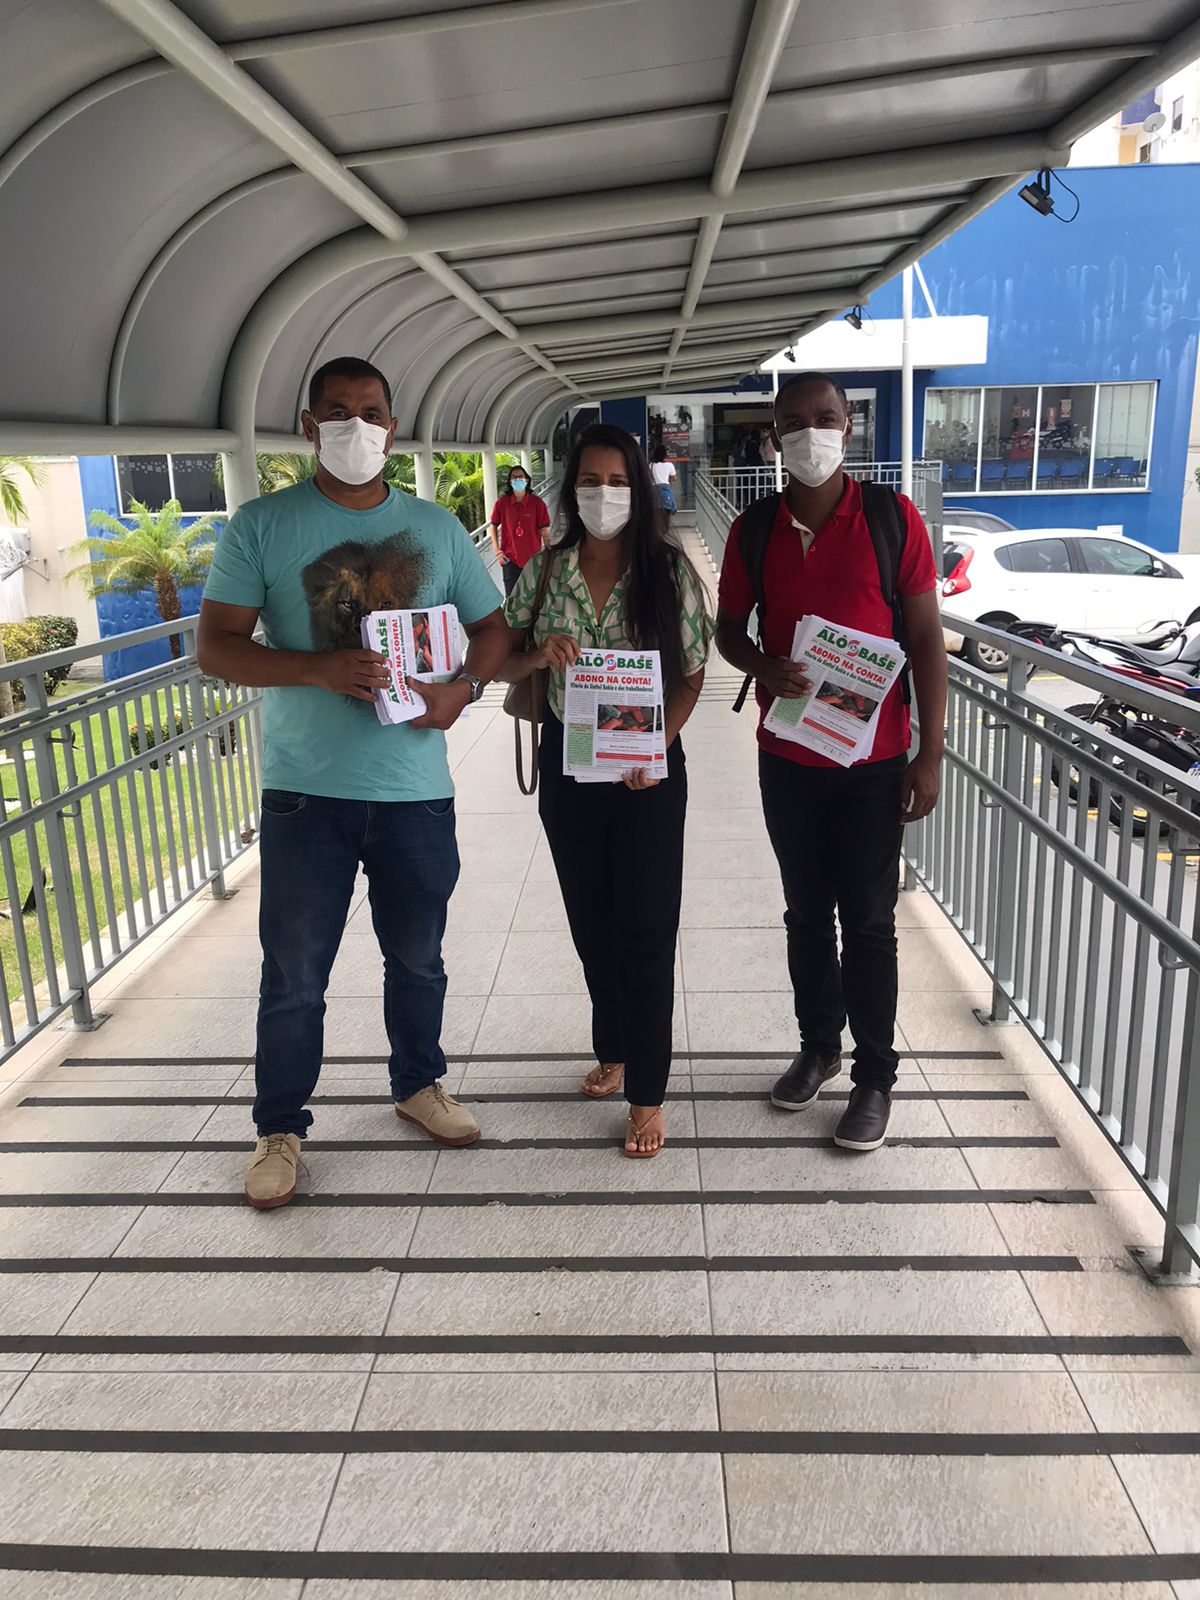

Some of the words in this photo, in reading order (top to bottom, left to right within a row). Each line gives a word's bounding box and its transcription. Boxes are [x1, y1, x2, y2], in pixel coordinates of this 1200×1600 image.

[378, 618, 389, 658] BASE
[391, 619, 400, 652] CONTA!
[816, 627, 848, 649] ALÔ
[858, 647, 896, 672] BASE
[395, 654, 402, 668] NA
[575, 653, 604, 667] ALÔ
[617, 657, 653, 670] BASE
[810, 645, 841, 664] ABONO
[841, 659, 854, 671] NA
[855, 666, 887, 685] CONTA!
[397, 670, 409, 702] ABONO
[574, 674, 604, 683] ABONO
[606, 675, 619, 684] NA
[621, 676, 652, 685] CONTA!
